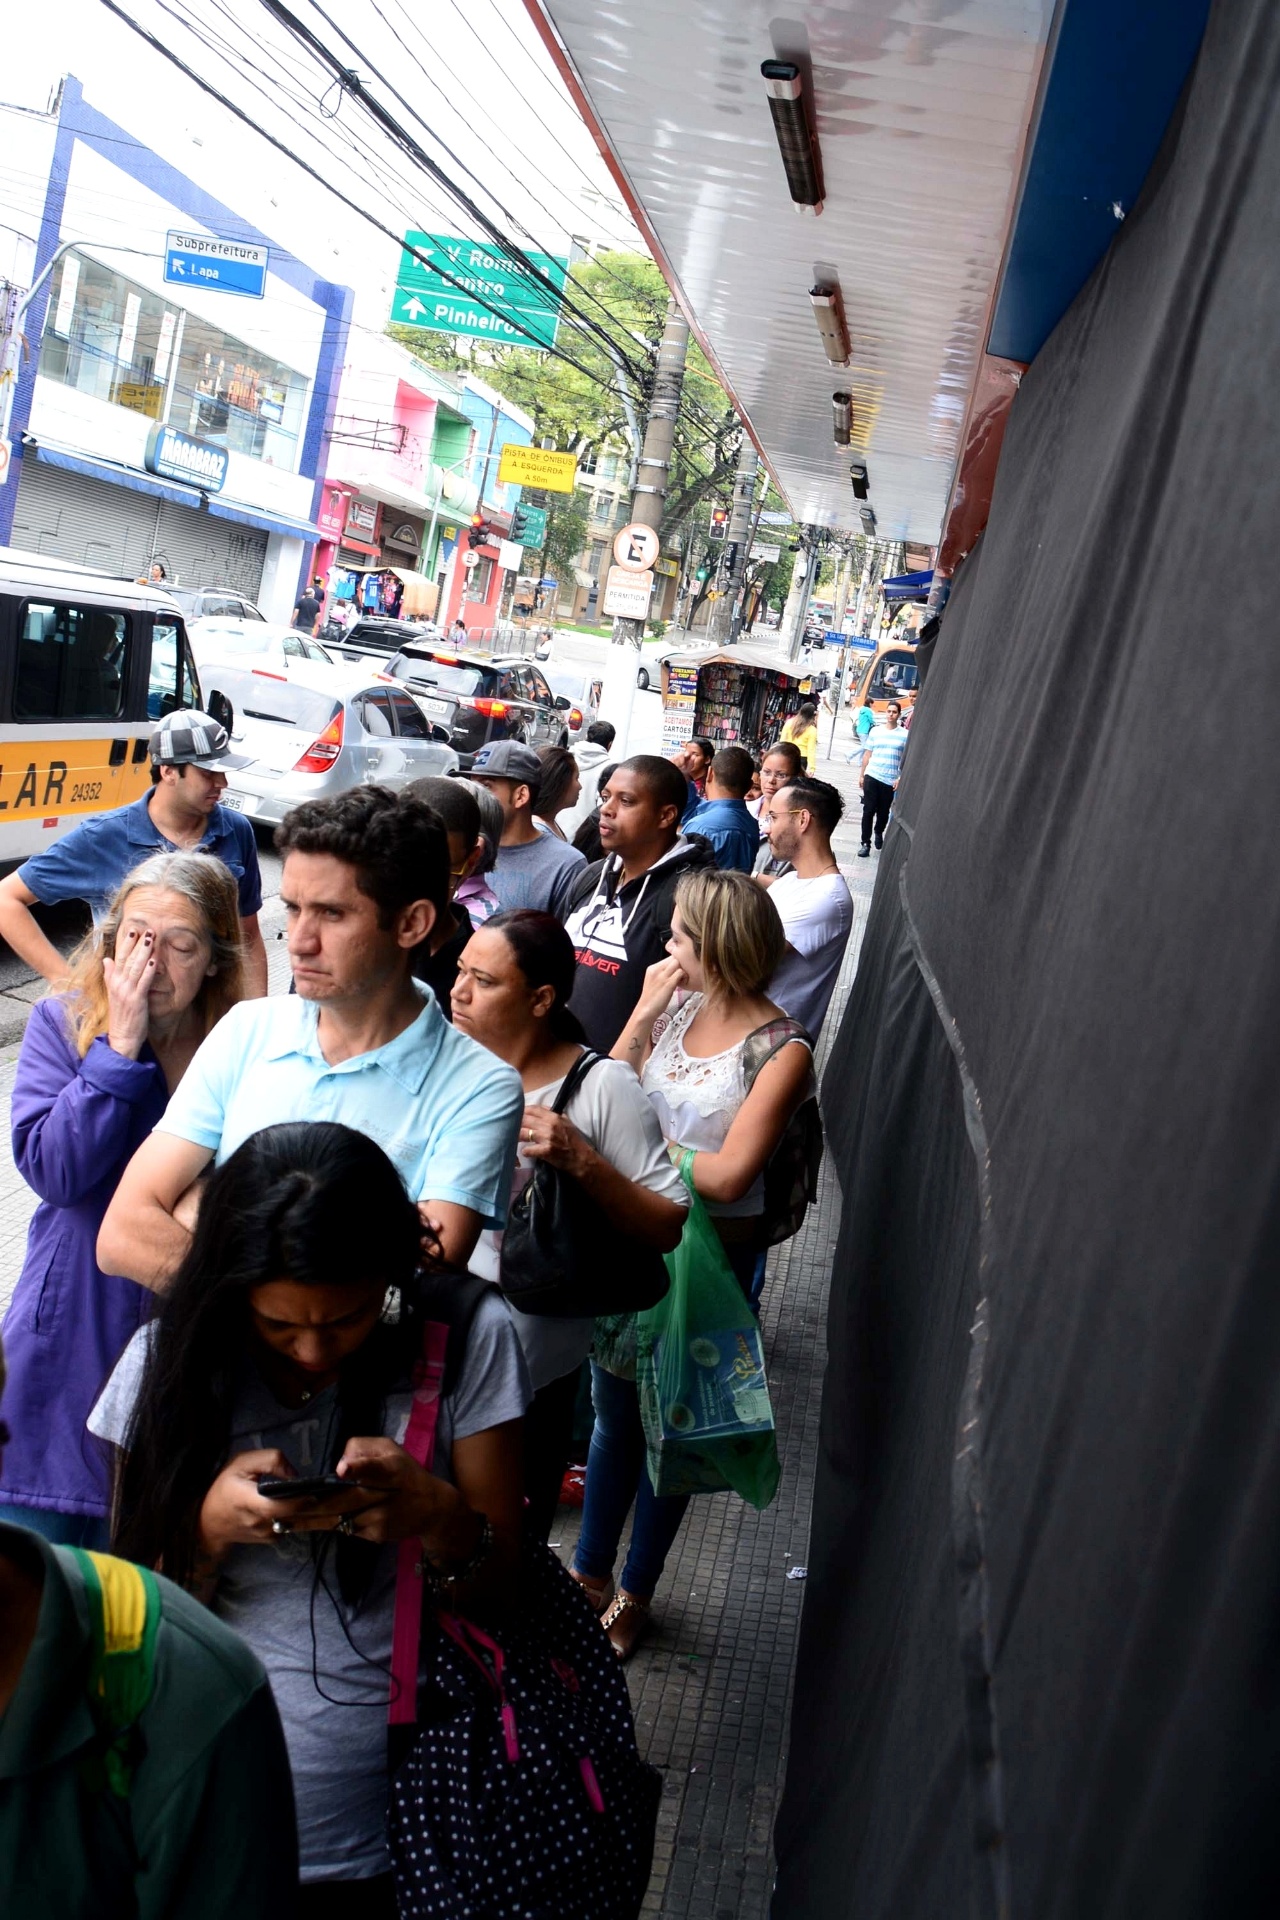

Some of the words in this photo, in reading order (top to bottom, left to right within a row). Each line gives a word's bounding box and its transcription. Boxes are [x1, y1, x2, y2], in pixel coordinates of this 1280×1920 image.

[176, 236, 259, 260] Subprefeitura
[191, 263, 219, 280] Lapa
[447, 246, 462, 262] V.
[470, 249, 549, 278] Romaa
[441, 270, 505, 296] Centro
[434, 303, 526, 337] Pinheiros
[160, 434, 226, 480] MARABRAZ
[504, 448, 526, 457] PISTA
[543, 454, 574, 466] ÔNIBUS
[521, 462, 563, 475] ESQUERDA
[532, 475, 548, 484] 50m
[609, 590, 645, 601] PERMITIDA
[663, 725, 692, 734] CARTÕES
[70, 782, 102, 802] 24352
